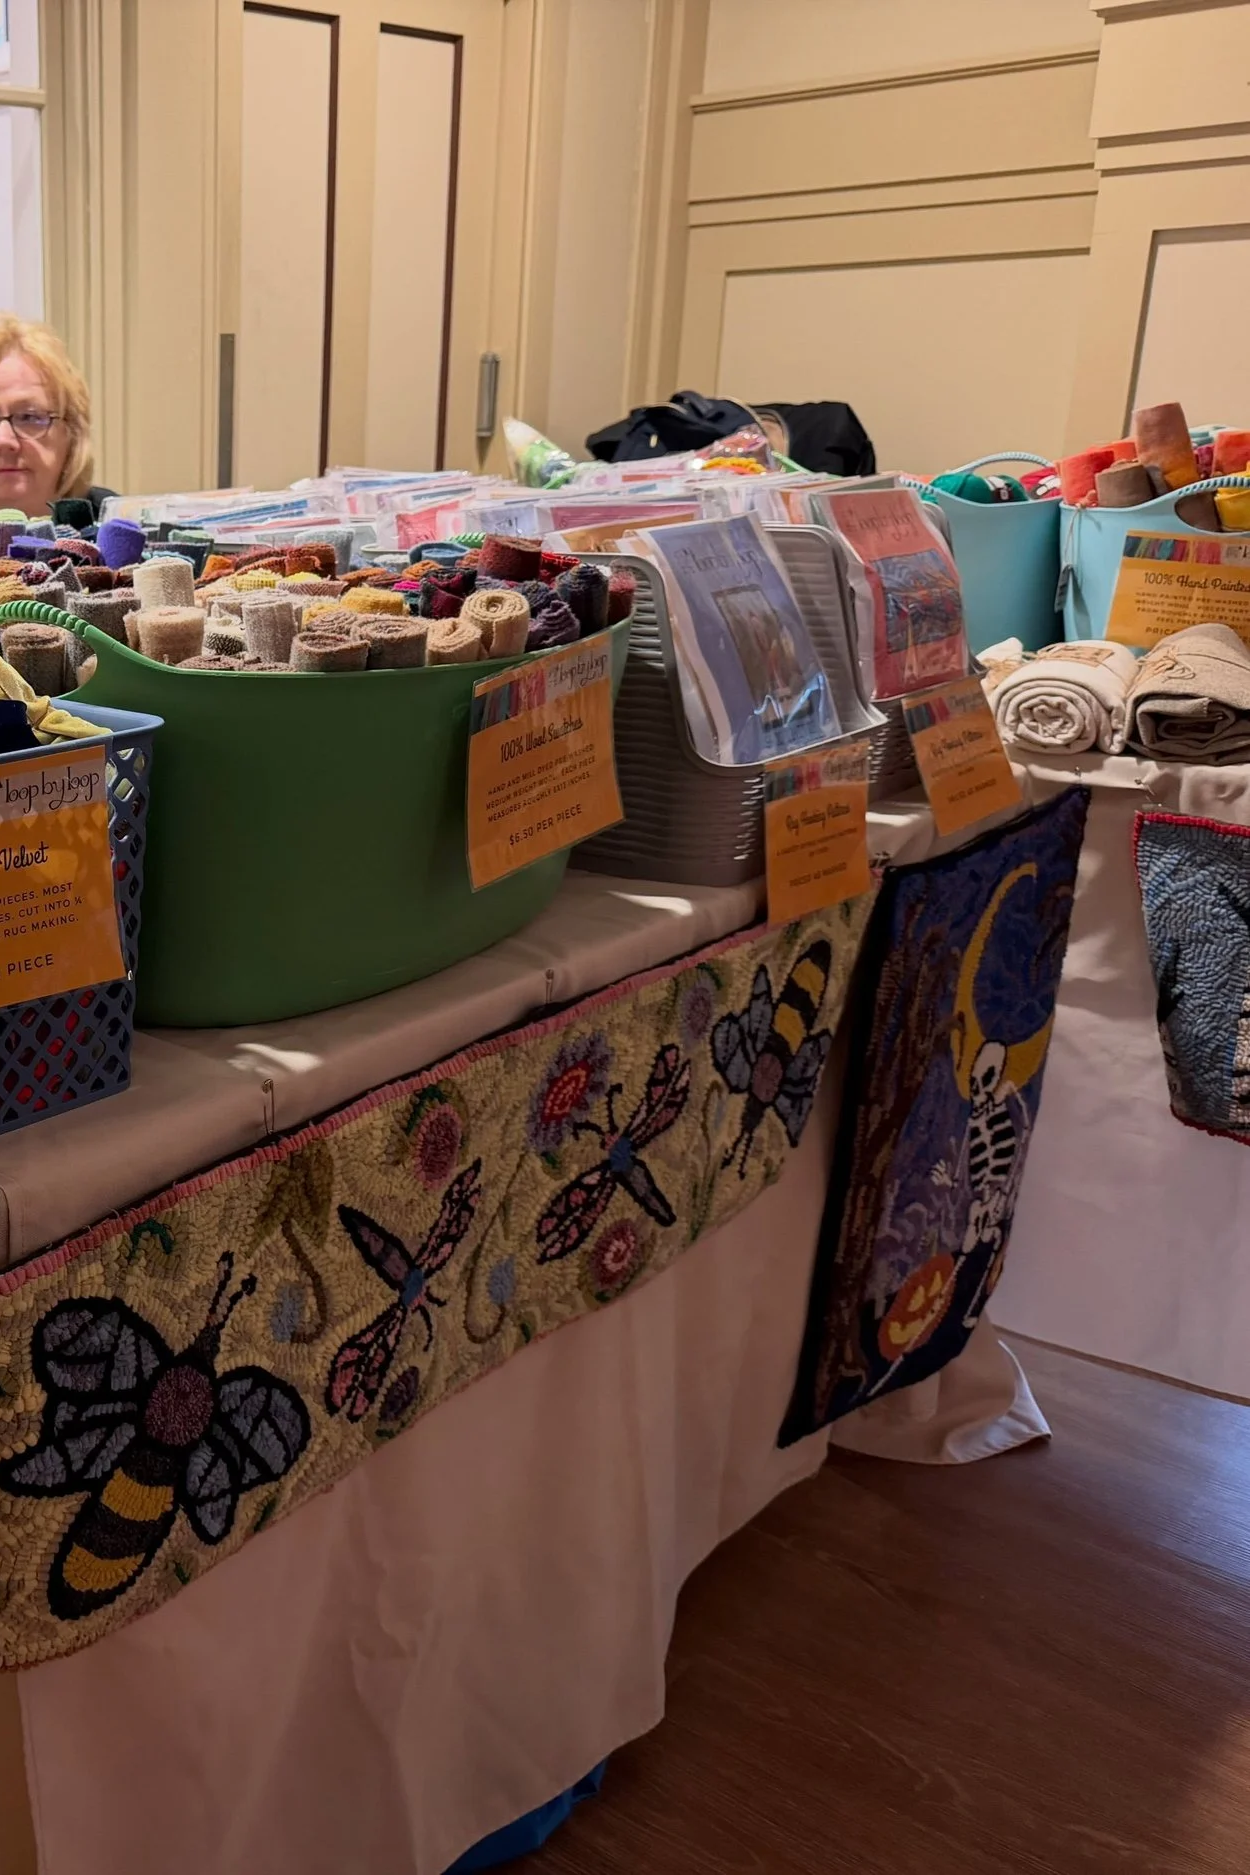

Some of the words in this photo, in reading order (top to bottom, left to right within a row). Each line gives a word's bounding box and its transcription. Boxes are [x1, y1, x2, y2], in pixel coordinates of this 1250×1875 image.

[1144, 572, 1173, 586] 100%
[1175, 574, 1208, 589] Hand
[500, 735, 524, 764] 100%
[525, 728, 547, 752] Wool
[547, 714, 584, 743] Swatches
[6, 778, 39, 814] loop
[41, 771, 78, 811] by
[67, 766, 101, 802] loop
[486, 794, 512, 811] MEDIUM
[513, 783, 538, 799] WEIGHT
[561, 763, 578, 777] EACH
[579, 755, 596, 770] PIECE
[488, 784, 506, 796] HAND
[507, 777, 522, 790] AND
[522, 769, 537, 786] MILL
[537, 763, 554, 778] DYED
[488, 806, 522, 824] MEASURES
[509, 825, 534, 846] $6.50
[536, 817, 554, 833] PER
[557, 803, 583, 822] PIECE
[42, 882, 74, 897] MOST
[18, 904, 40, 919] CUT
[44, 898, 71, 913] INTO
[4, 925, 28, 939] RUG
[31, 914, 80, 932] MAKING.
[7, 953, 55, 975] PIECE
